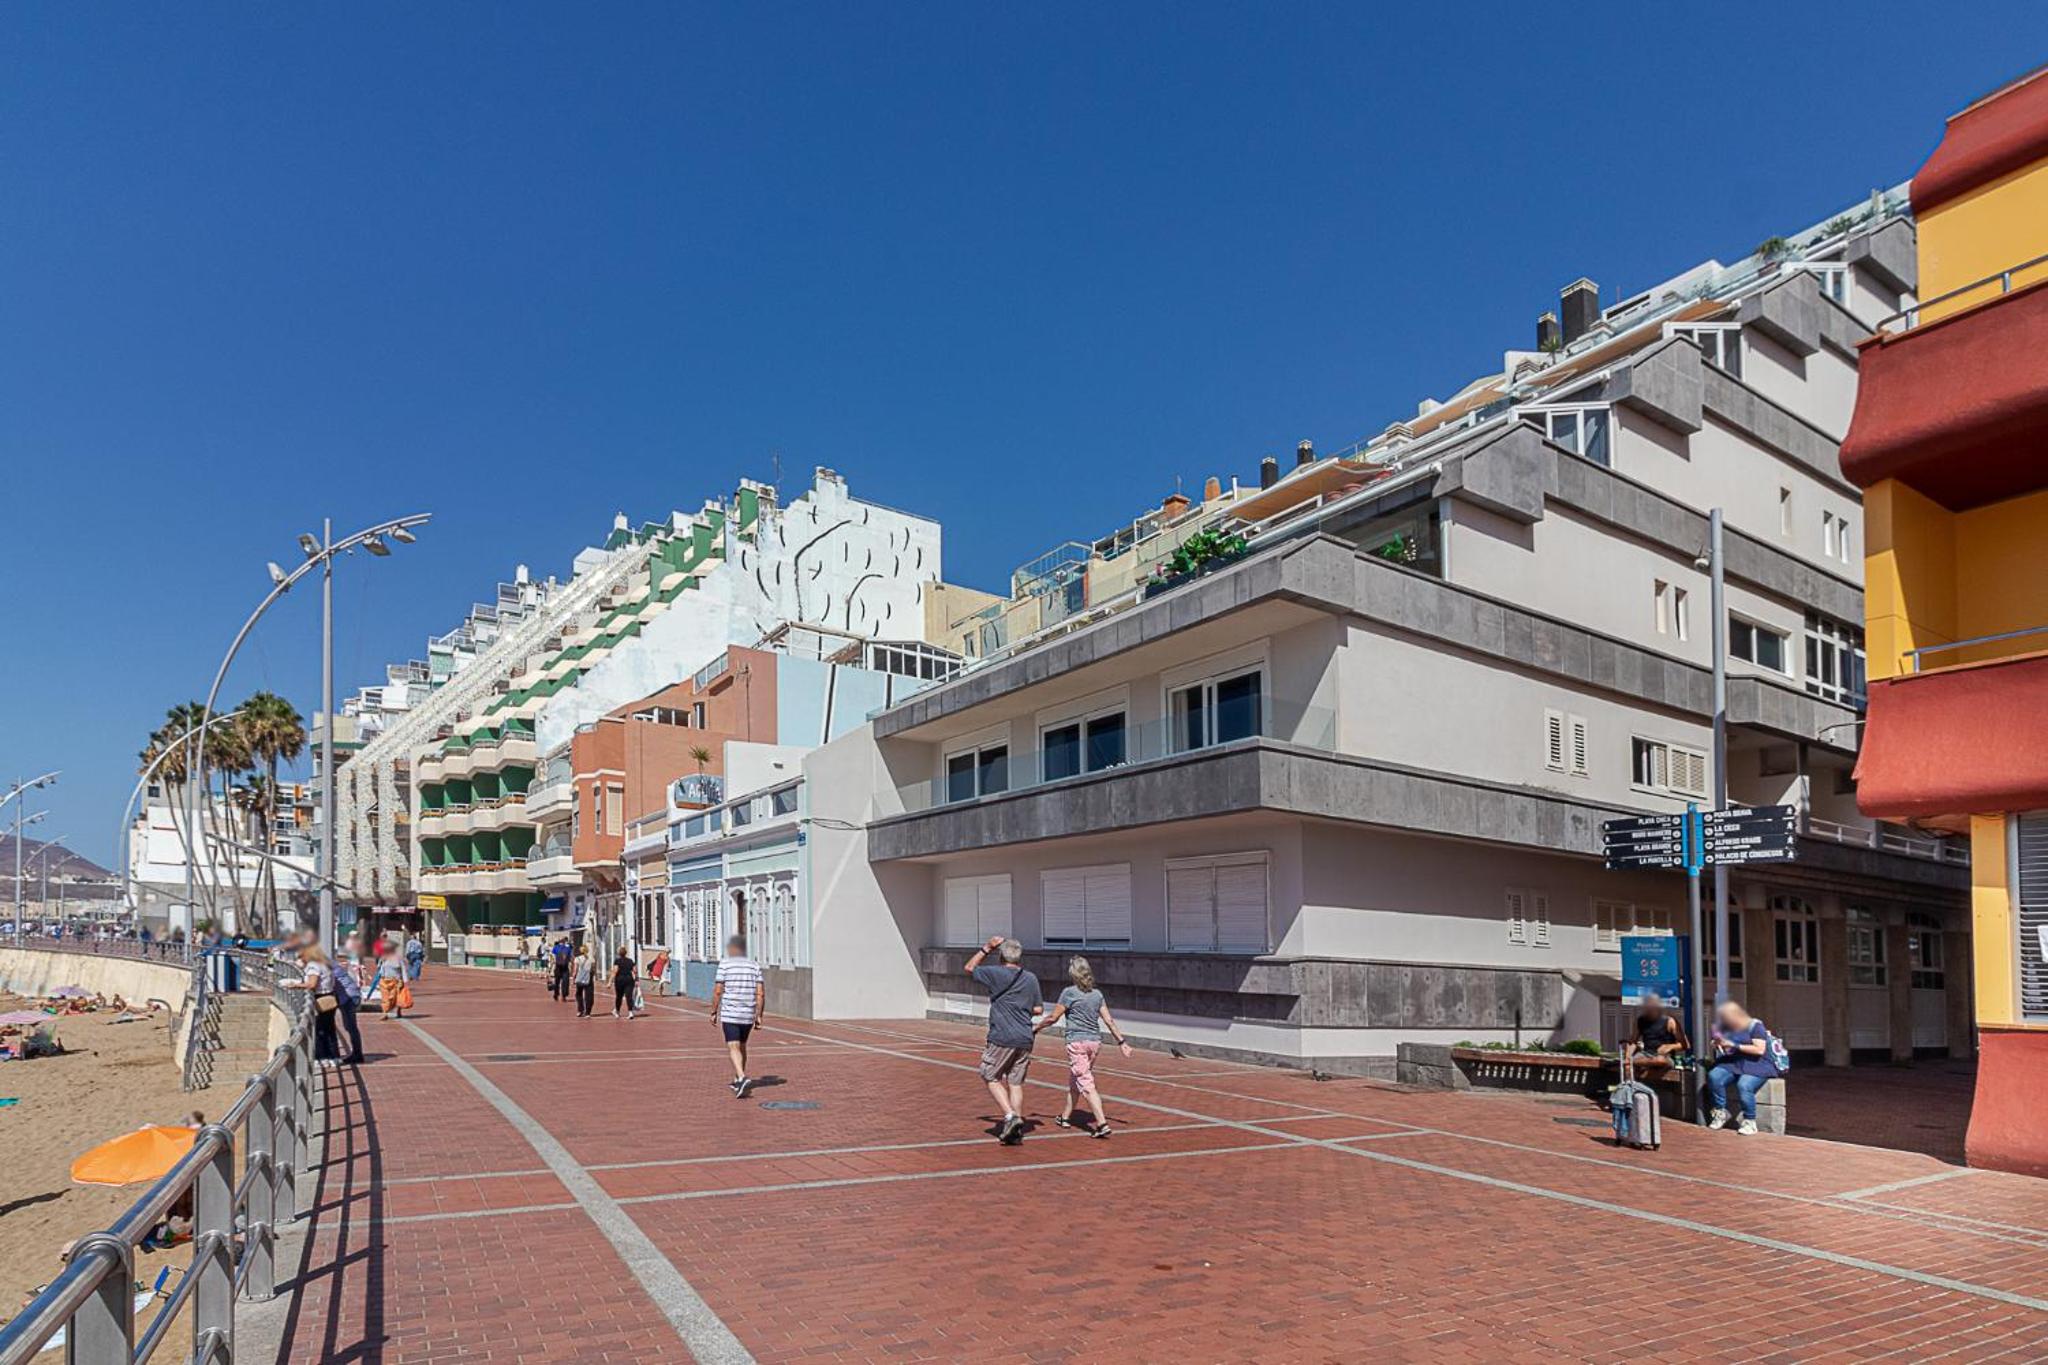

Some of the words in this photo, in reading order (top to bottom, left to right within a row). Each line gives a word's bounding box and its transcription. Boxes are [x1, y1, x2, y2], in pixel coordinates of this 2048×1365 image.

[1638, 816, 1655, 825] PLAYA
[1656, 815, 1671, 823] CHICA
[1714, 838, 1740, 846] ALFREDO
[1741, 836, 1762, 844] KRAUS
[1634, 844, 1651, 852] PLAYA
[1714, 852, 1739, 860] PALACIO
[1740, 851, 1748, 859] DE
[1748, 849, 1784, 858] CONGRESOS
[1639, 857, 1647, 865] LA
[1648, 856, 1673, 864] PUNTILLA
